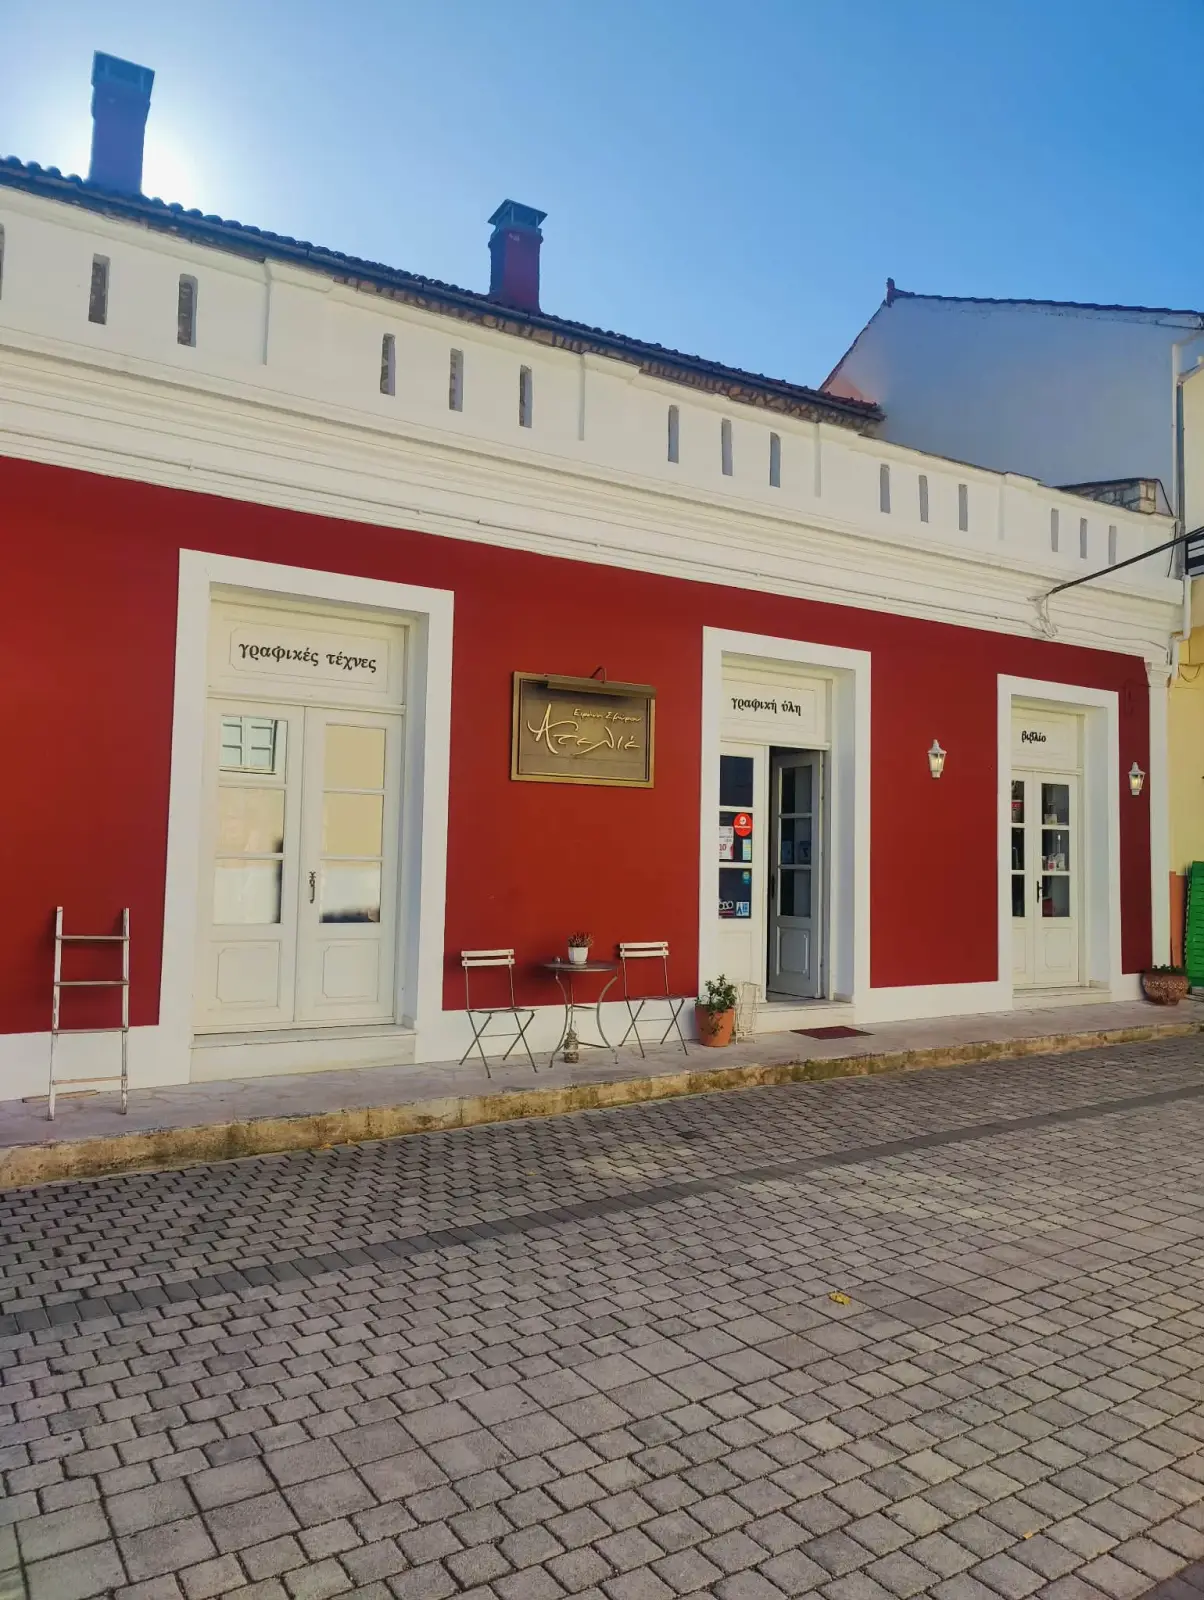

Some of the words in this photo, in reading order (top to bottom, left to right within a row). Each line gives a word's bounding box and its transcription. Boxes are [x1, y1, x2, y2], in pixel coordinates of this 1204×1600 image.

[238, 643, 319, 667] γραφικές
[325, 651, 377, 673] τέχνες
[731, 697, 777, 714] γραφική
[781, 700, 802, 716] ύλη
[1021, 730, 1047, 744] βιβλίο
